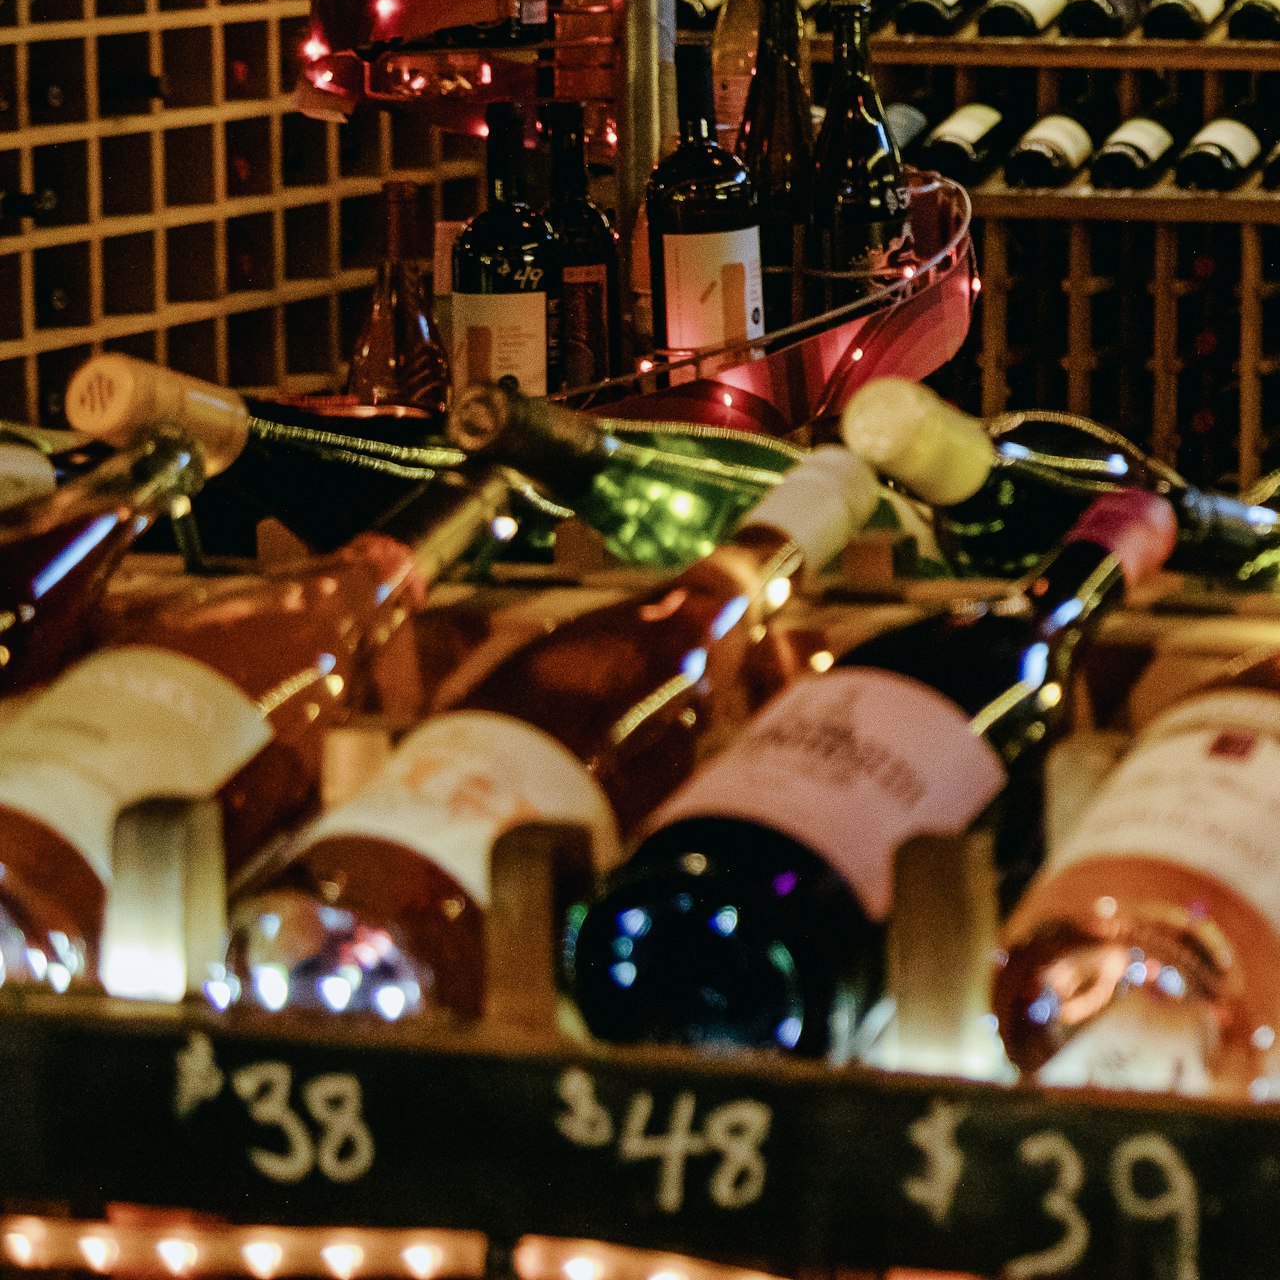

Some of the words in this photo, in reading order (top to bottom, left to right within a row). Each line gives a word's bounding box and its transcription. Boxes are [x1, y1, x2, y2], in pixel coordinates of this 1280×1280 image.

[497, 258, 545, 290] $49
[174, 1032, 377, 1184] $38
[554, 1065, 773, 1213] $48
[903, 1099, 1201, 1280] $39
